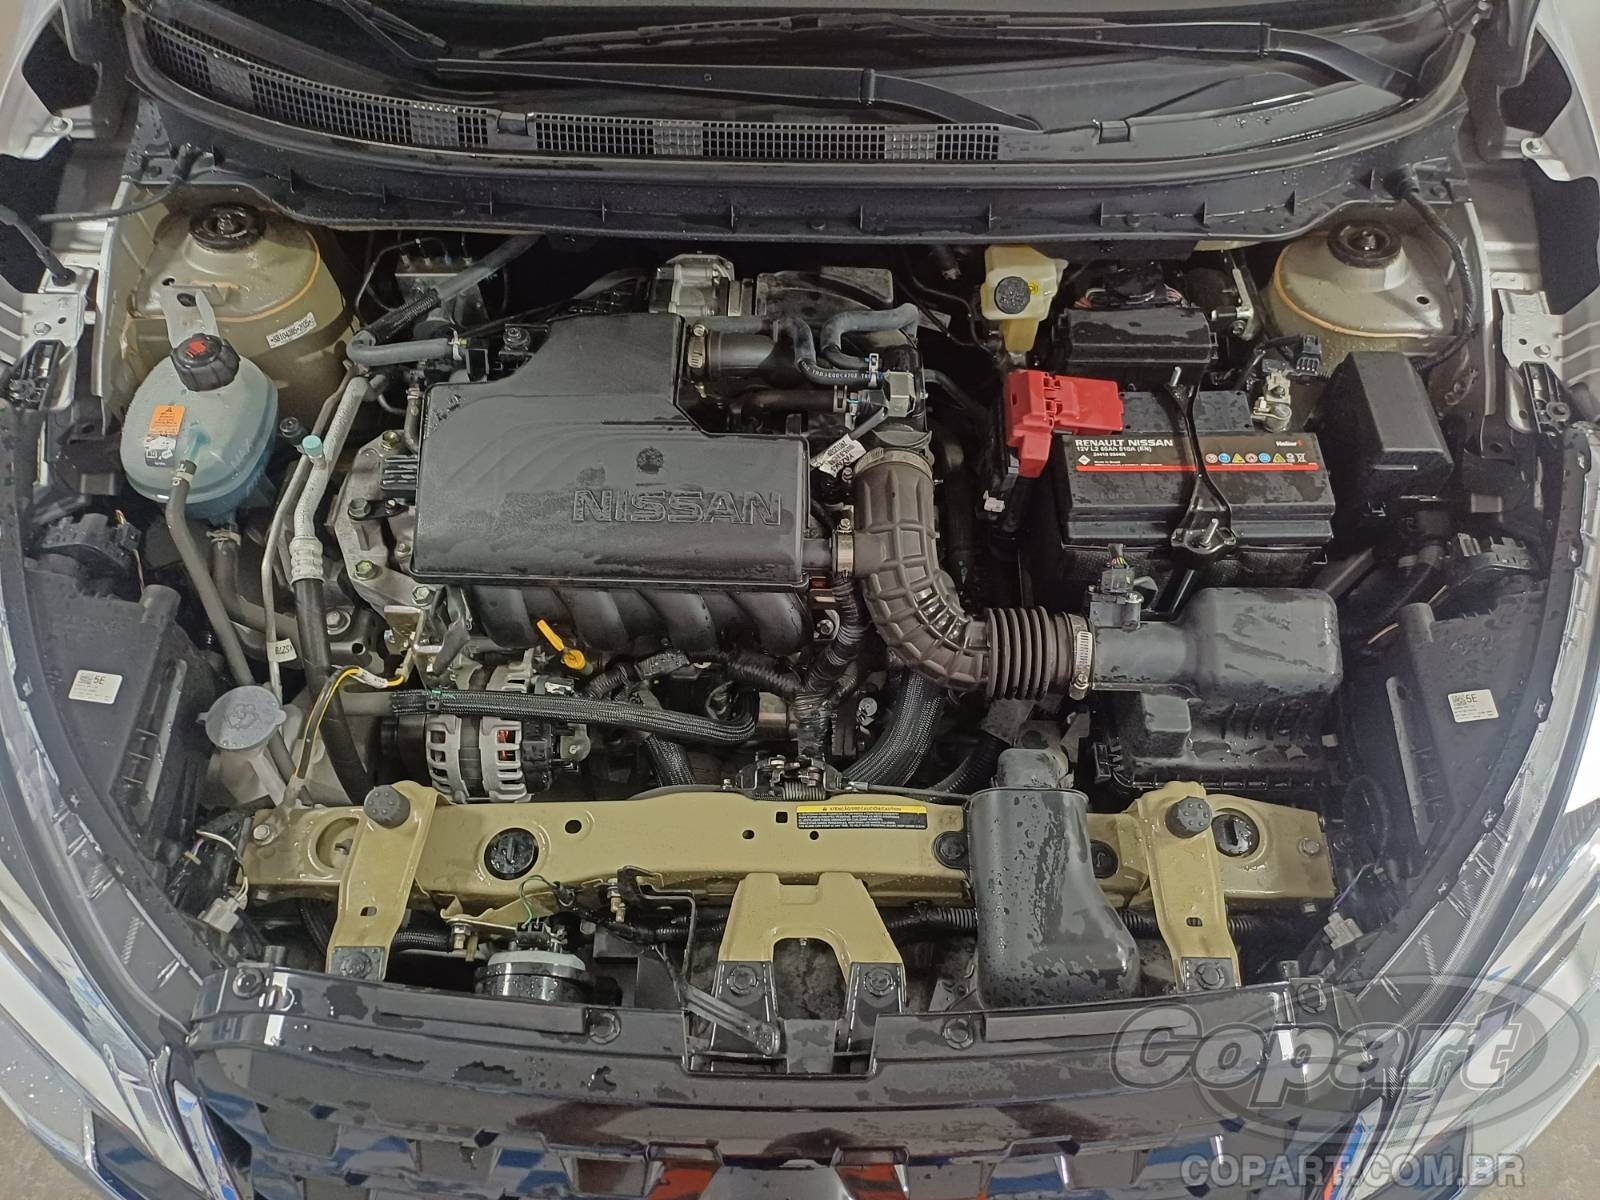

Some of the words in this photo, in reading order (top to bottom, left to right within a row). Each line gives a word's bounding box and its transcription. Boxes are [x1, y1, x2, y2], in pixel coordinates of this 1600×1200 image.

[1075, 439, 1125, 447] RENAULT
[1127, 439, 1174, 447] NISSAN
[572, 489, 781, 525] NISSAN
[1465, 694, 1479, 703] 5E
